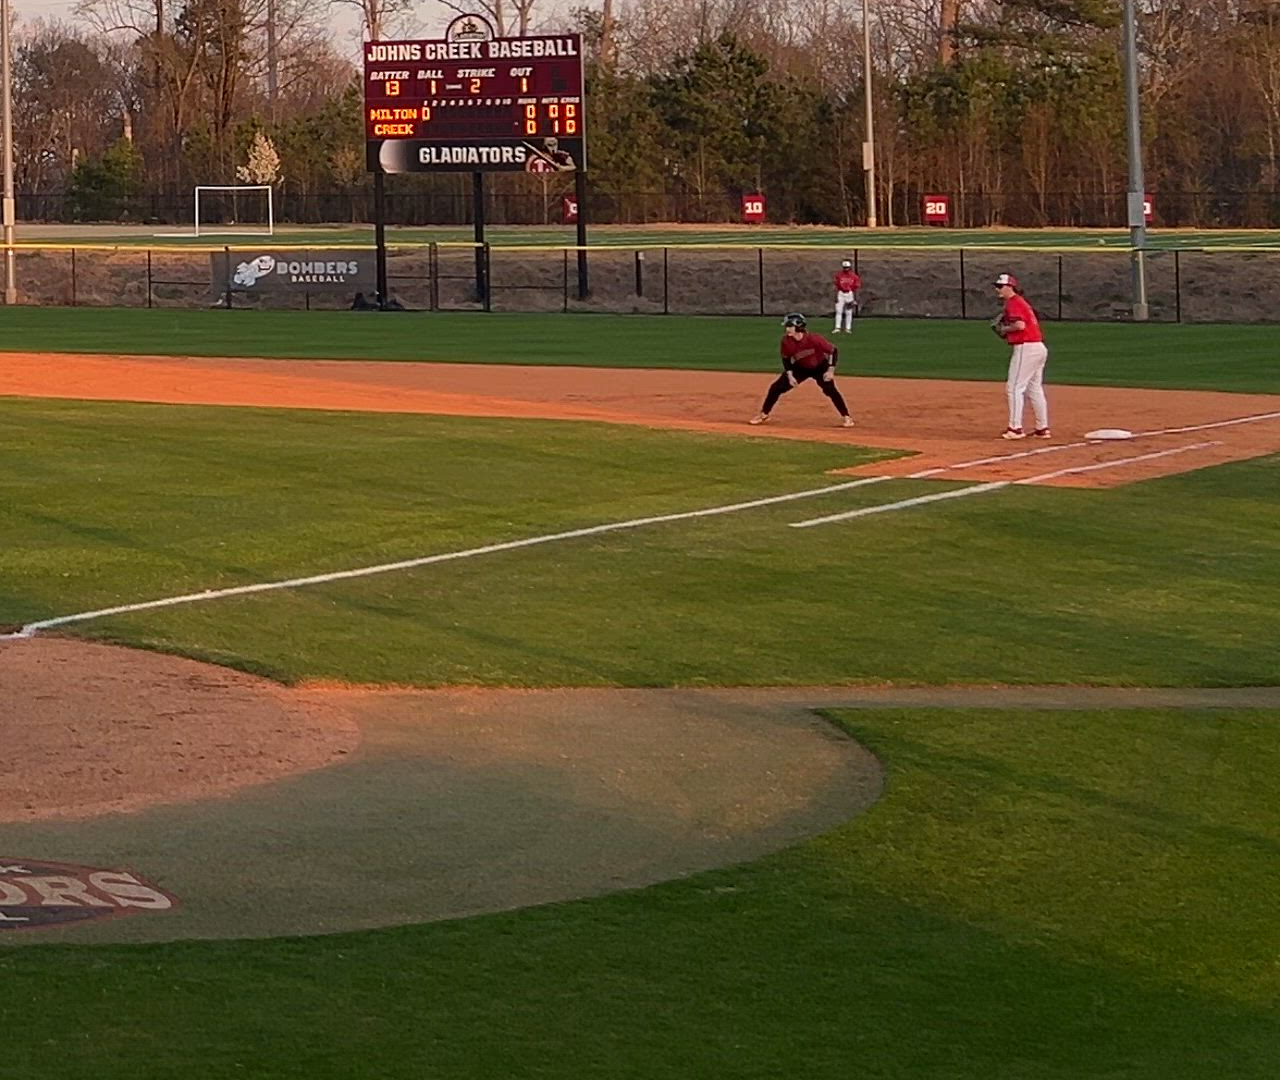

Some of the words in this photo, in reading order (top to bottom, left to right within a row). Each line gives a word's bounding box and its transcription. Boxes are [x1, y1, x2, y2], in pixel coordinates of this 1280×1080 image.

[368, 44, 421, 61] JOHNS
[425, 42, 482, 60] CREEK
[488, 39, 577, 58] BASEBALL
[370, 71, 410, 80] BATTER
[417, 70, 444, 79] BALL
[456, 68, 496, 78] STRIKE
[510, 67, 533, 77] OUT
[385, 81, 399, 96] 13
[431, 80, 436, 95] 1
[470, 78, 480, 93] 2
[522, 77, 527, 93] 1
[370, 109, 417, 121] MILTON
[422, 107, 430, 121] 0
[526, 104, 536, 119] 0
[549, 104, 558, 118] 0
[566, 104, 575, 117] 0
[374, 124, 414, 135] CREEK
[527, 120, 536, 134] 0
[554, 120, 559, 133] 1
[566, 120, 576, 134] 0
[419, 146, 526, 163] GLADIATORS
[745, 202, 763, 214] 10
[926, 202, 946, 215] 20
[276, 261, 358, 275] BOMBERS
